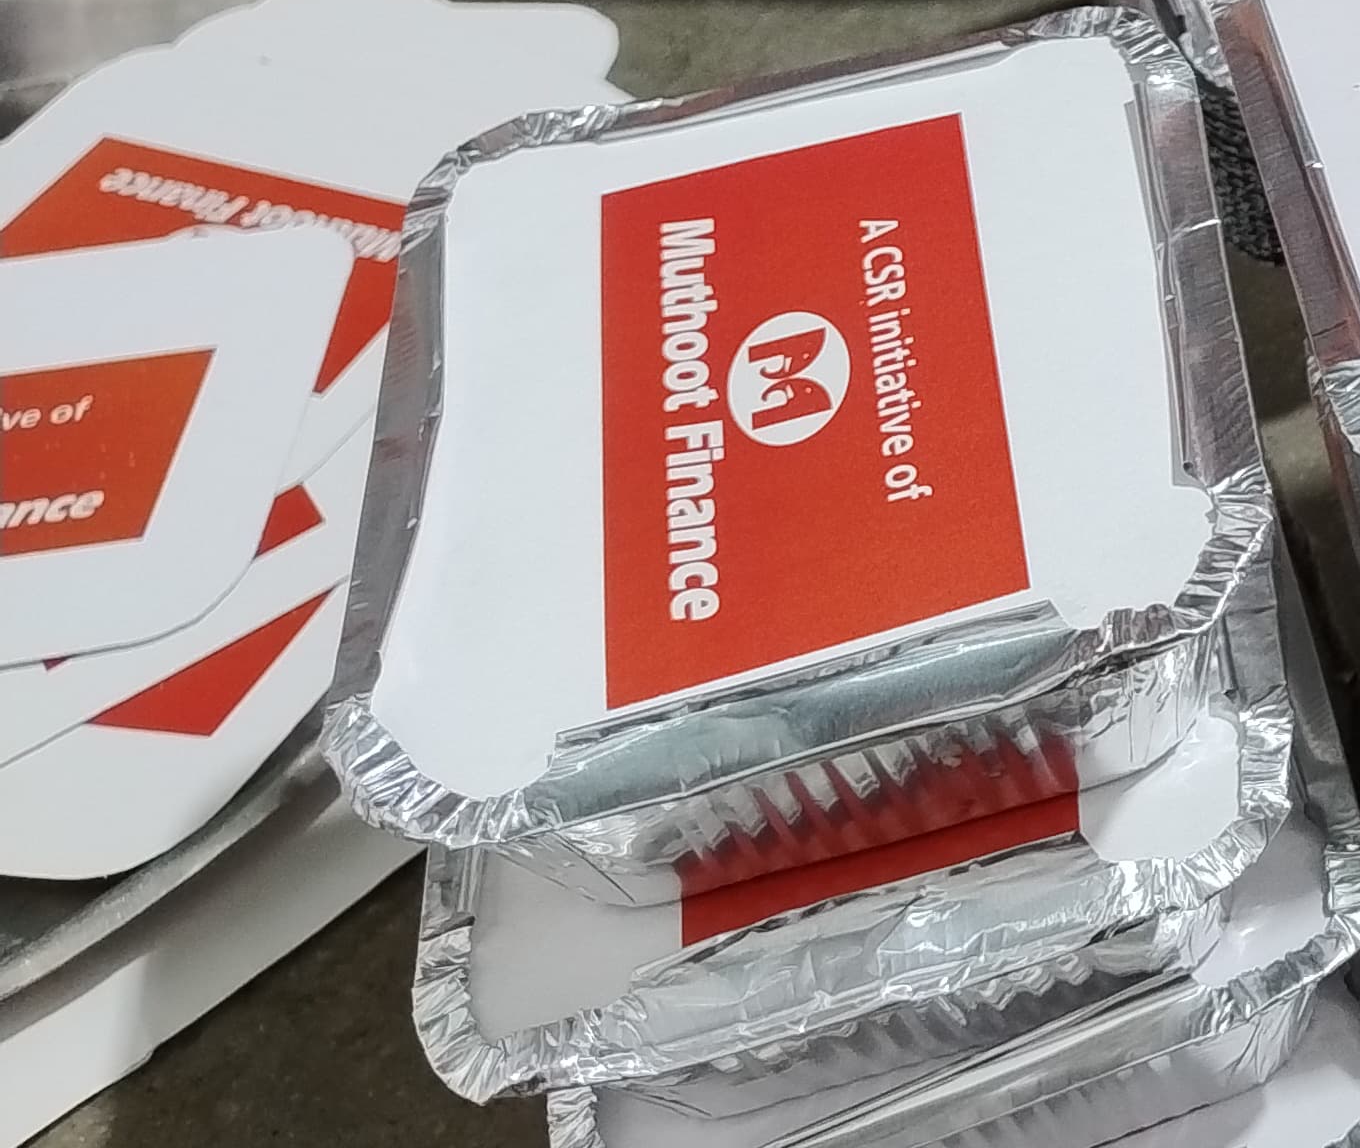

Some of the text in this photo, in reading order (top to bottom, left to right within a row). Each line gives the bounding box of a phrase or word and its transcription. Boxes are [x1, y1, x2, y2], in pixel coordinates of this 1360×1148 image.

[50, 395, 94, 423] of
[660, 217, 724, 621] Muthoot Finance
[857, 218, 934, 503] A CSR initiative of
